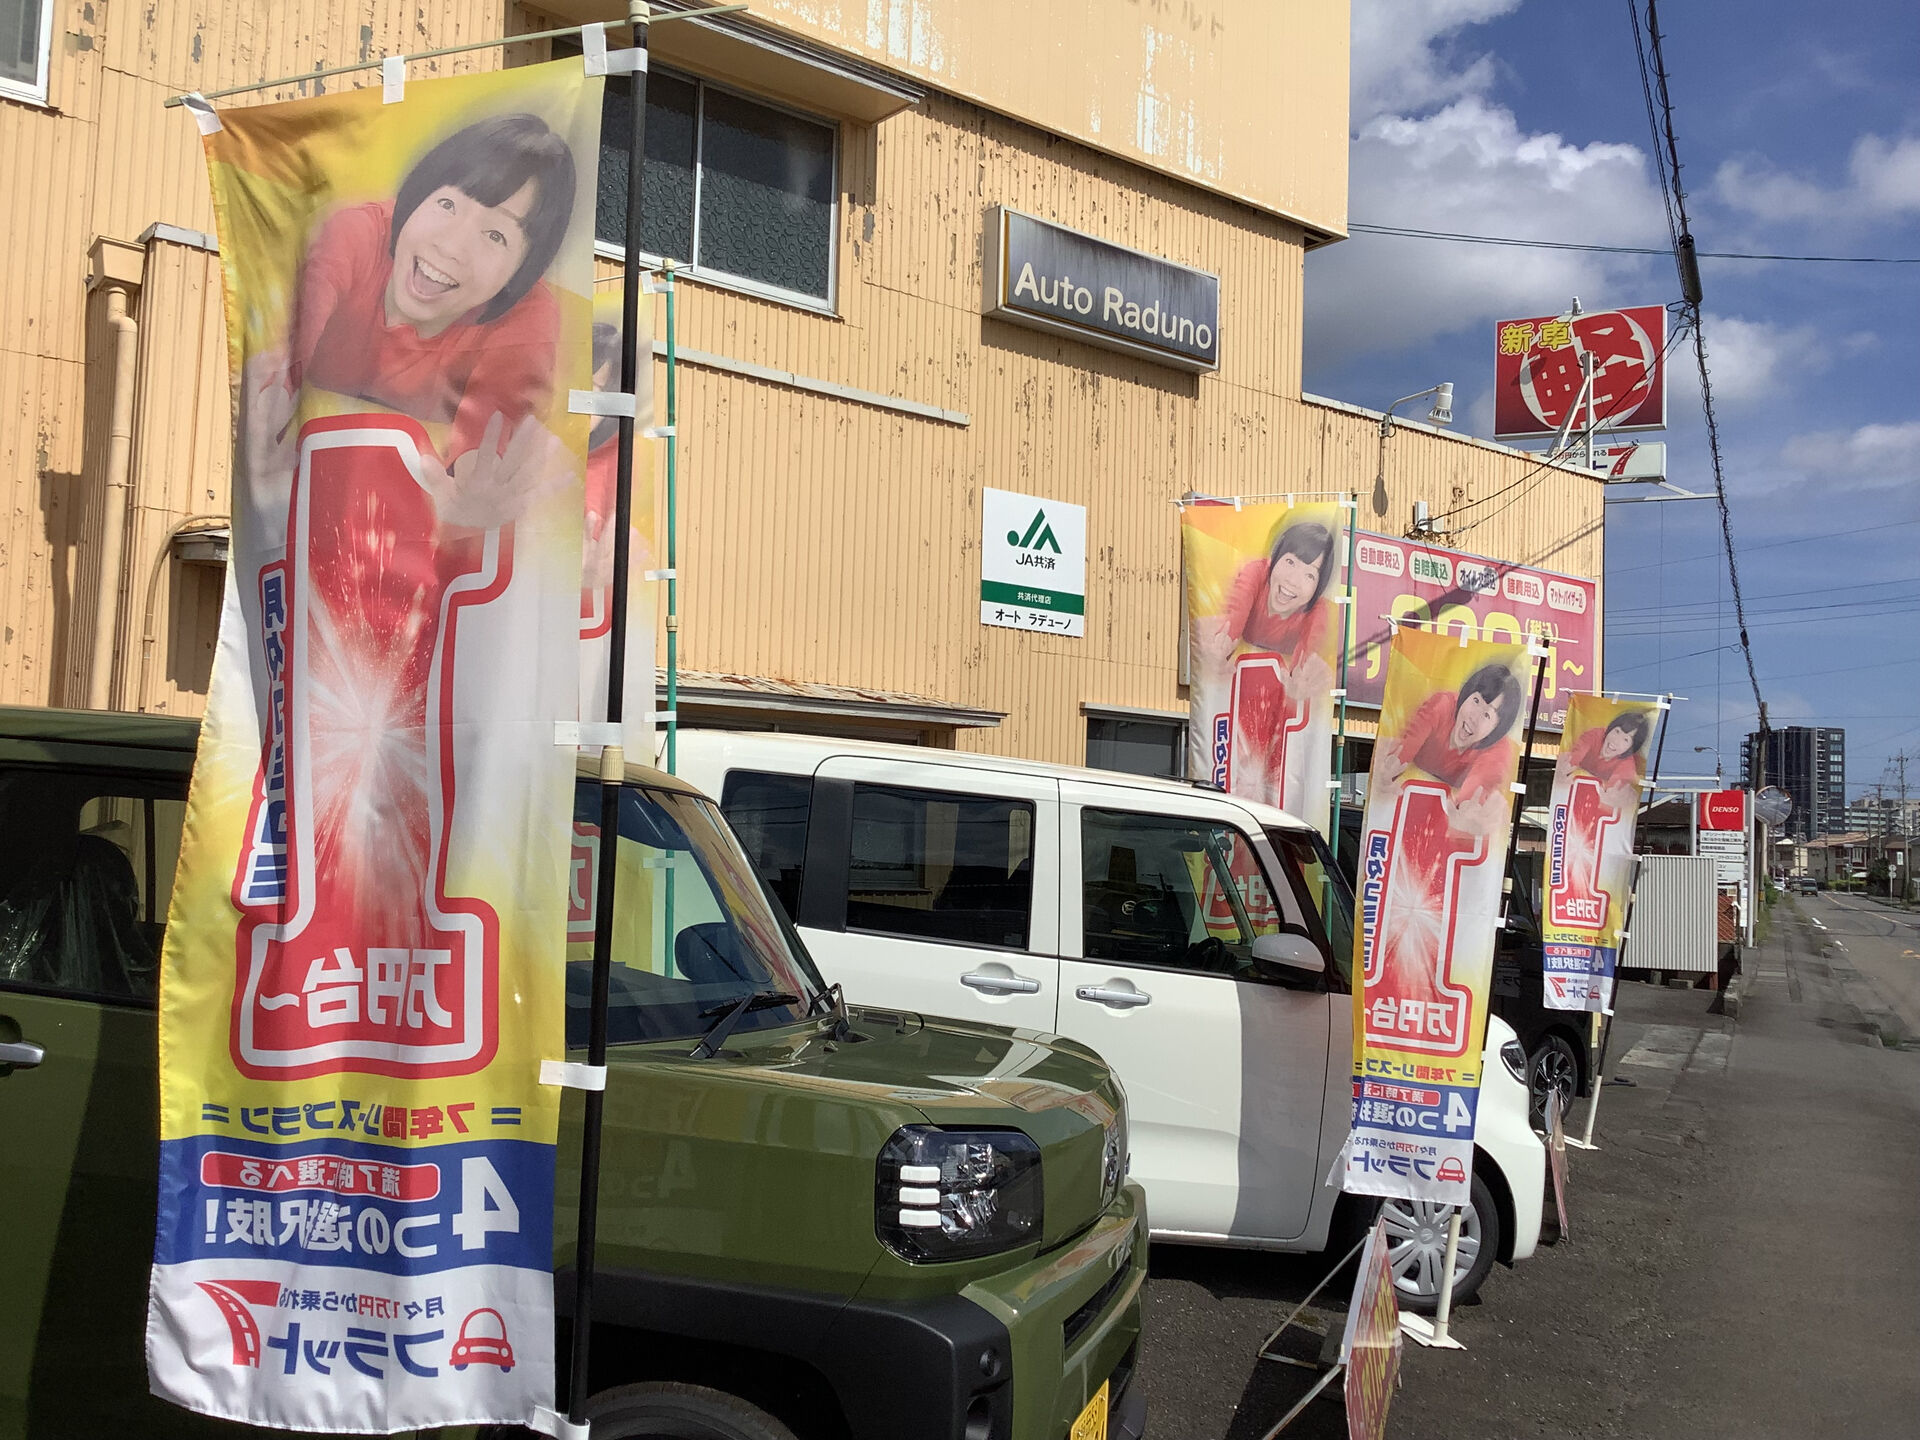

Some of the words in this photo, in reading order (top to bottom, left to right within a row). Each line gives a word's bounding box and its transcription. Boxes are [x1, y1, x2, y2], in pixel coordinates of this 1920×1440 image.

[1014, 261, 1093, 315] Auto
[1103, 286, 1212, 350] Raduno
[1500, 320, 1571, 355] 新車
[1016, 553, 1056, 571] JA共済
[1360, 547, 1401, 570] 自動車税込
[1413, 557, 1449, 581] 自賠責込
[1017, 591, 1052, 605] 共済代理店
[1507, 580, 1541, 601] 諸費用込
[995, 608, 1021, 624] オート
[1028, 612, 1072, 630] ラデューノ
[1711, 806, 1740, 814] DENSO
